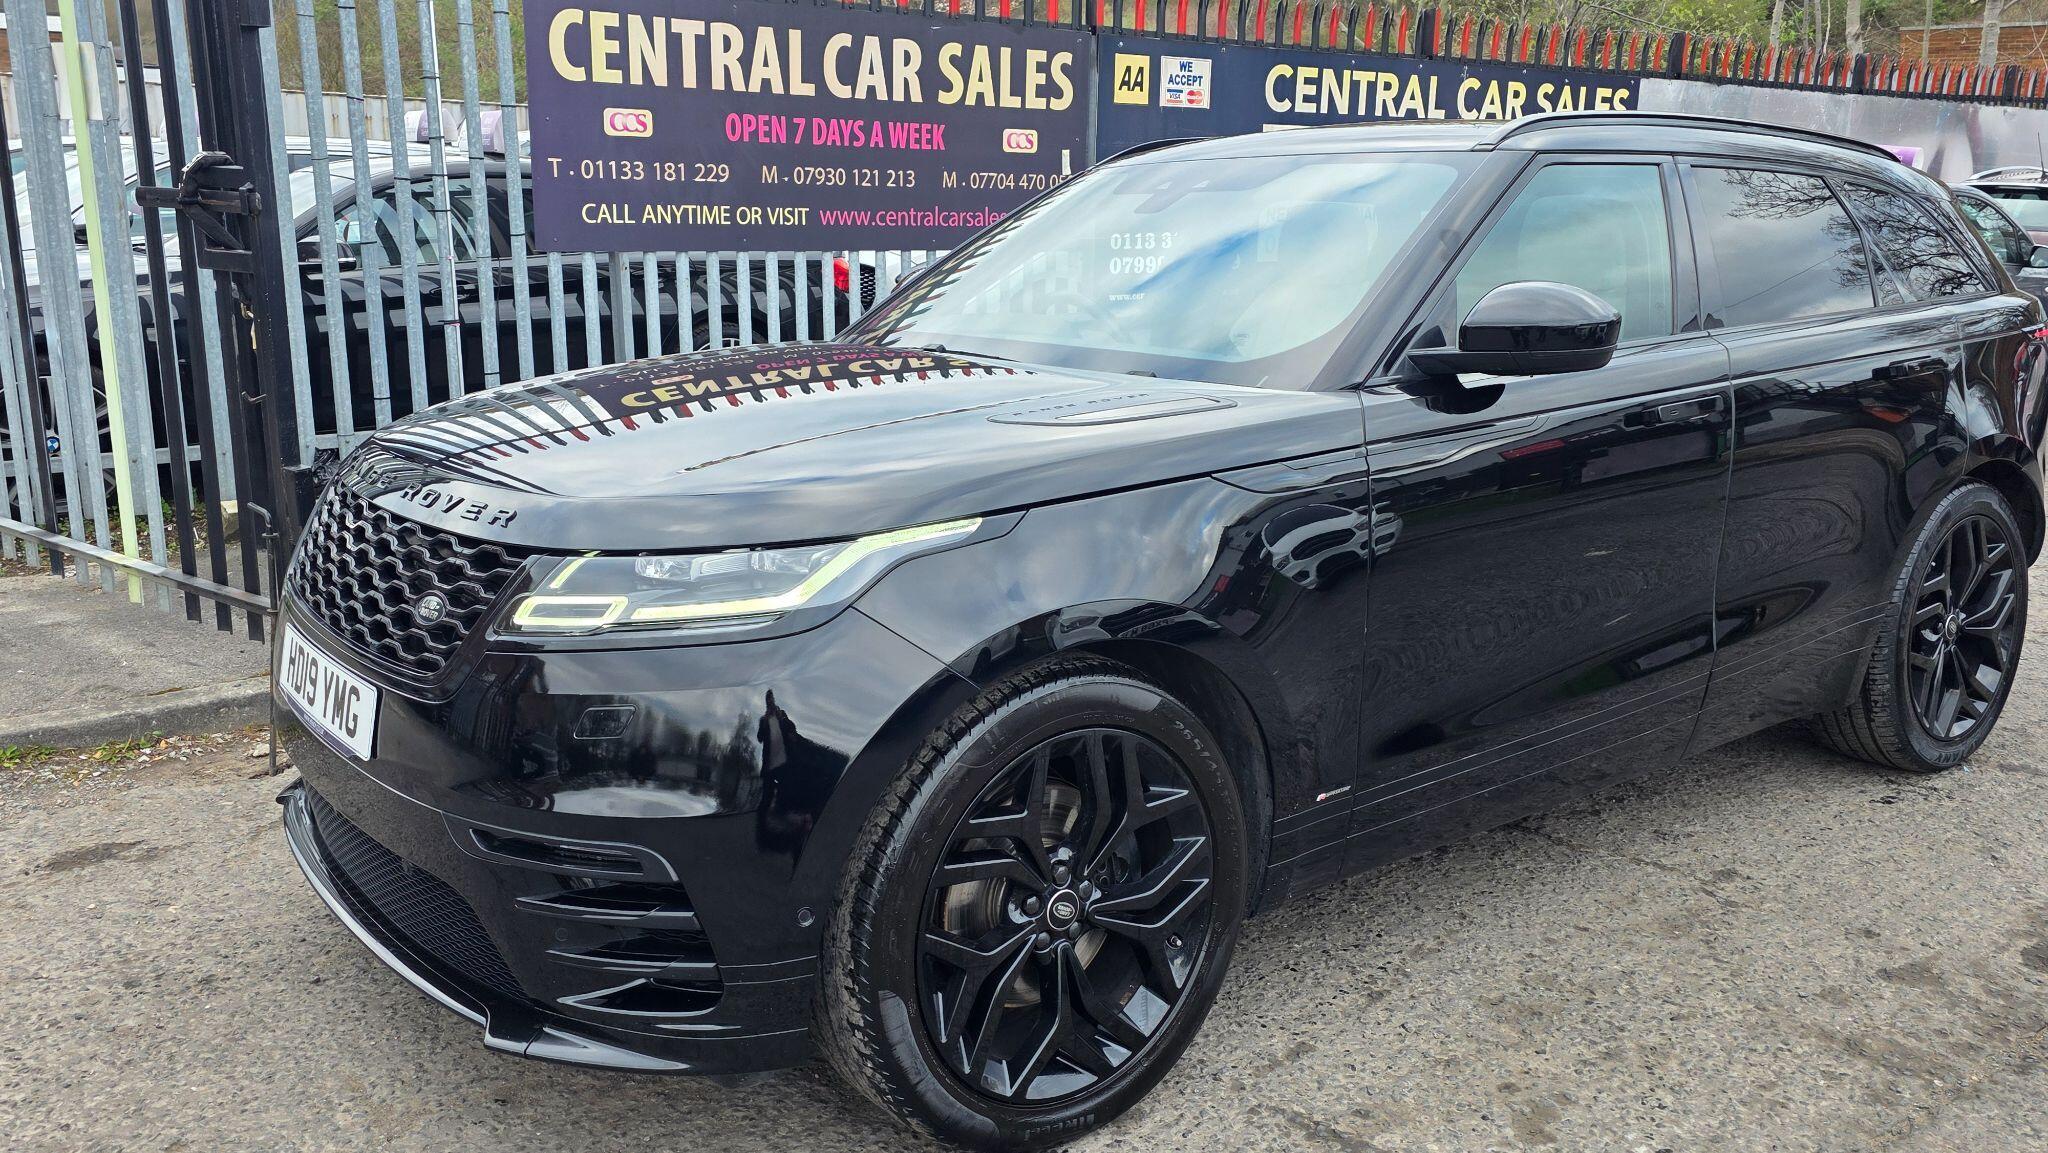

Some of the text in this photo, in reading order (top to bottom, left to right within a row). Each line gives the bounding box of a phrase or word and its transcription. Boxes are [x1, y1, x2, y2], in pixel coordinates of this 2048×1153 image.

[549, 8, 1075, 111] CENTRAL CAR SALES
[1179, 61, 1193, 72] WE
[1118, 65, 1144, 93] AA
[1167, 74, 1204, 87] ACCEPT
[1265, 64, 1446, 119] CENTRAL
[1457, 77, 1527, 120] CAR
[725, 112, 946, 151] OPEN 7 DAYS A WEEK
[580, 159, 645, 181] 01133
[653, 162, 686, 182] 181
[693, 163, 730, 183] 229
[793, 166, 847, 187] 07930
[852, 168, 880, 187] 121
[886, 169, 916, 188] 213
[970, 172, 1015, 190] 07704
[1018, 174, 1045, 190] 470
[581, 203, 636, 225] CALL
[642, 204, 731, 226] ANYTIME
[736, 206, 763, 226] OR
[767, 207, 810, 227] VISIT
[400, 482, 518, 529] ROVER
[287, 637, 361, 739] HD19 YMG
